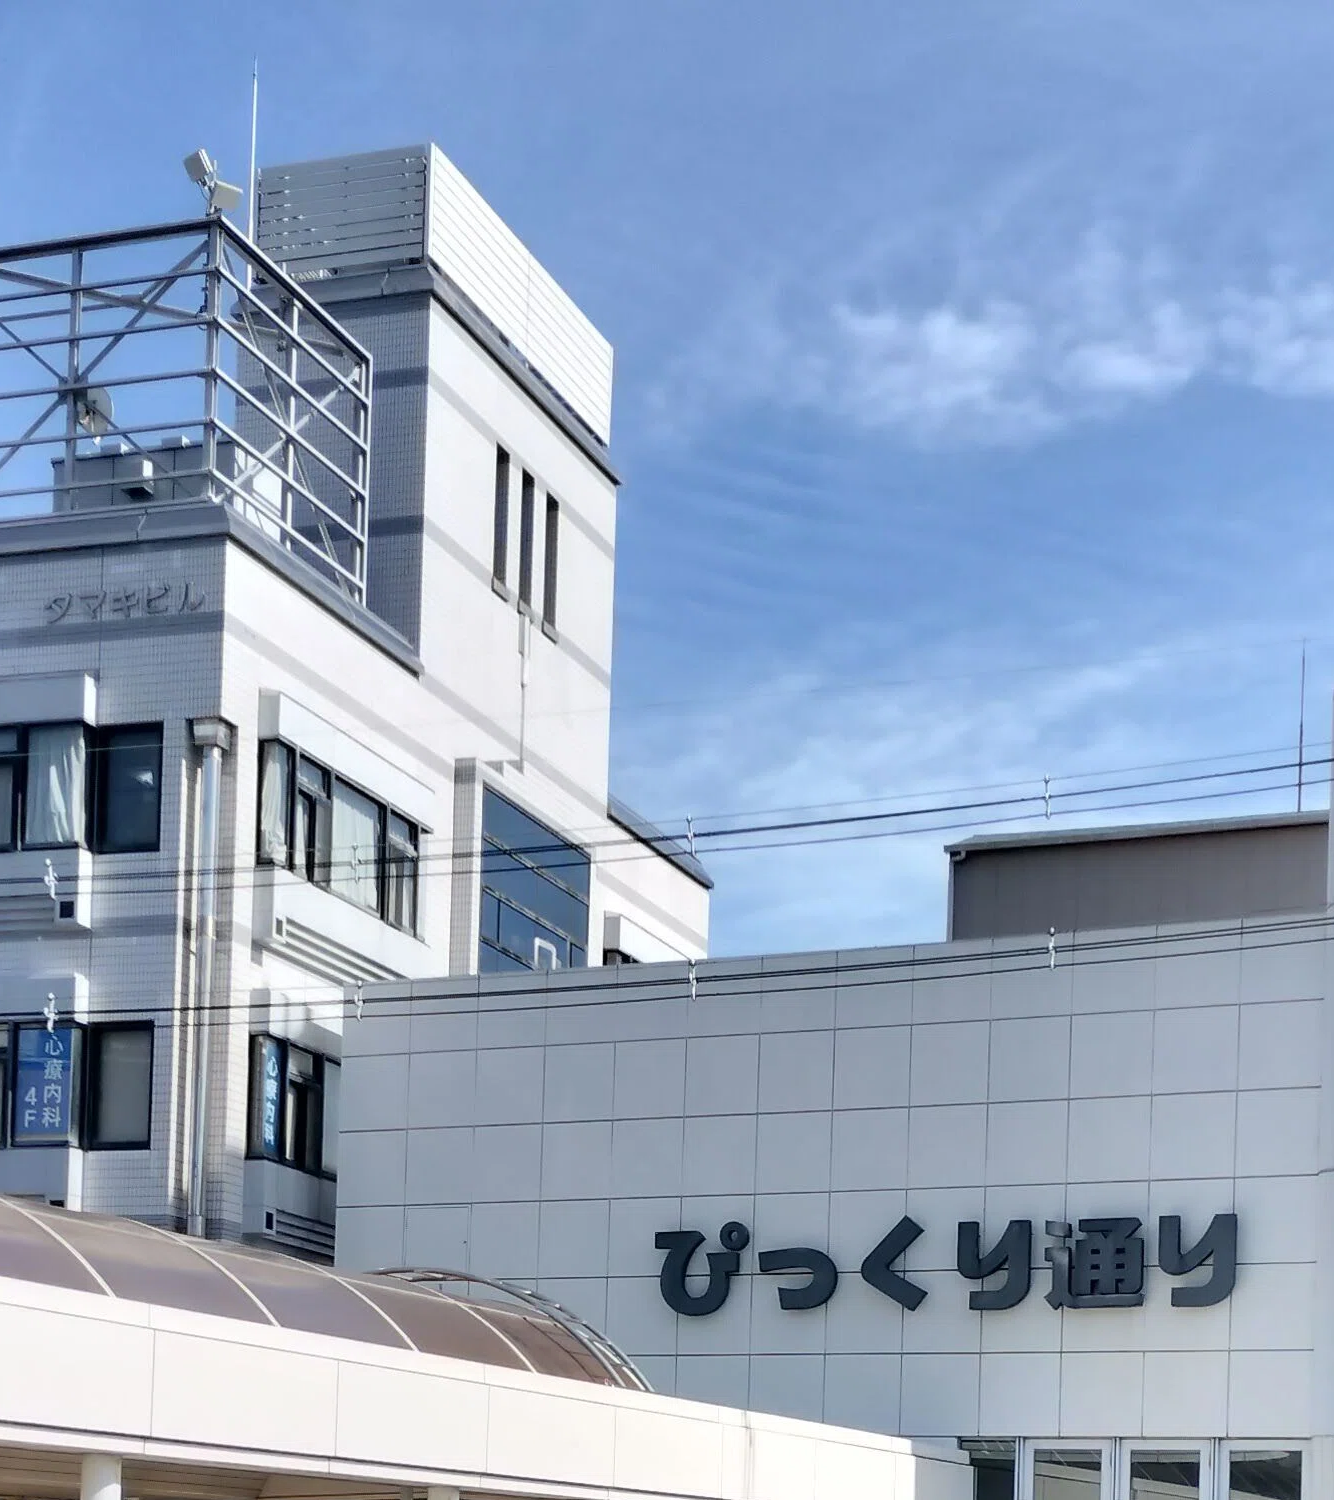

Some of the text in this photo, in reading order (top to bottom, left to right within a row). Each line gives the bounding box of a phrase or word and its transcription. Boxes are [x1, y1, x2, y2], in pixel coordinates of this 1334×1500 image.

[44, 582, 205, 624] タマキビル
[42, 1035, 64, 1128] 心療内科
